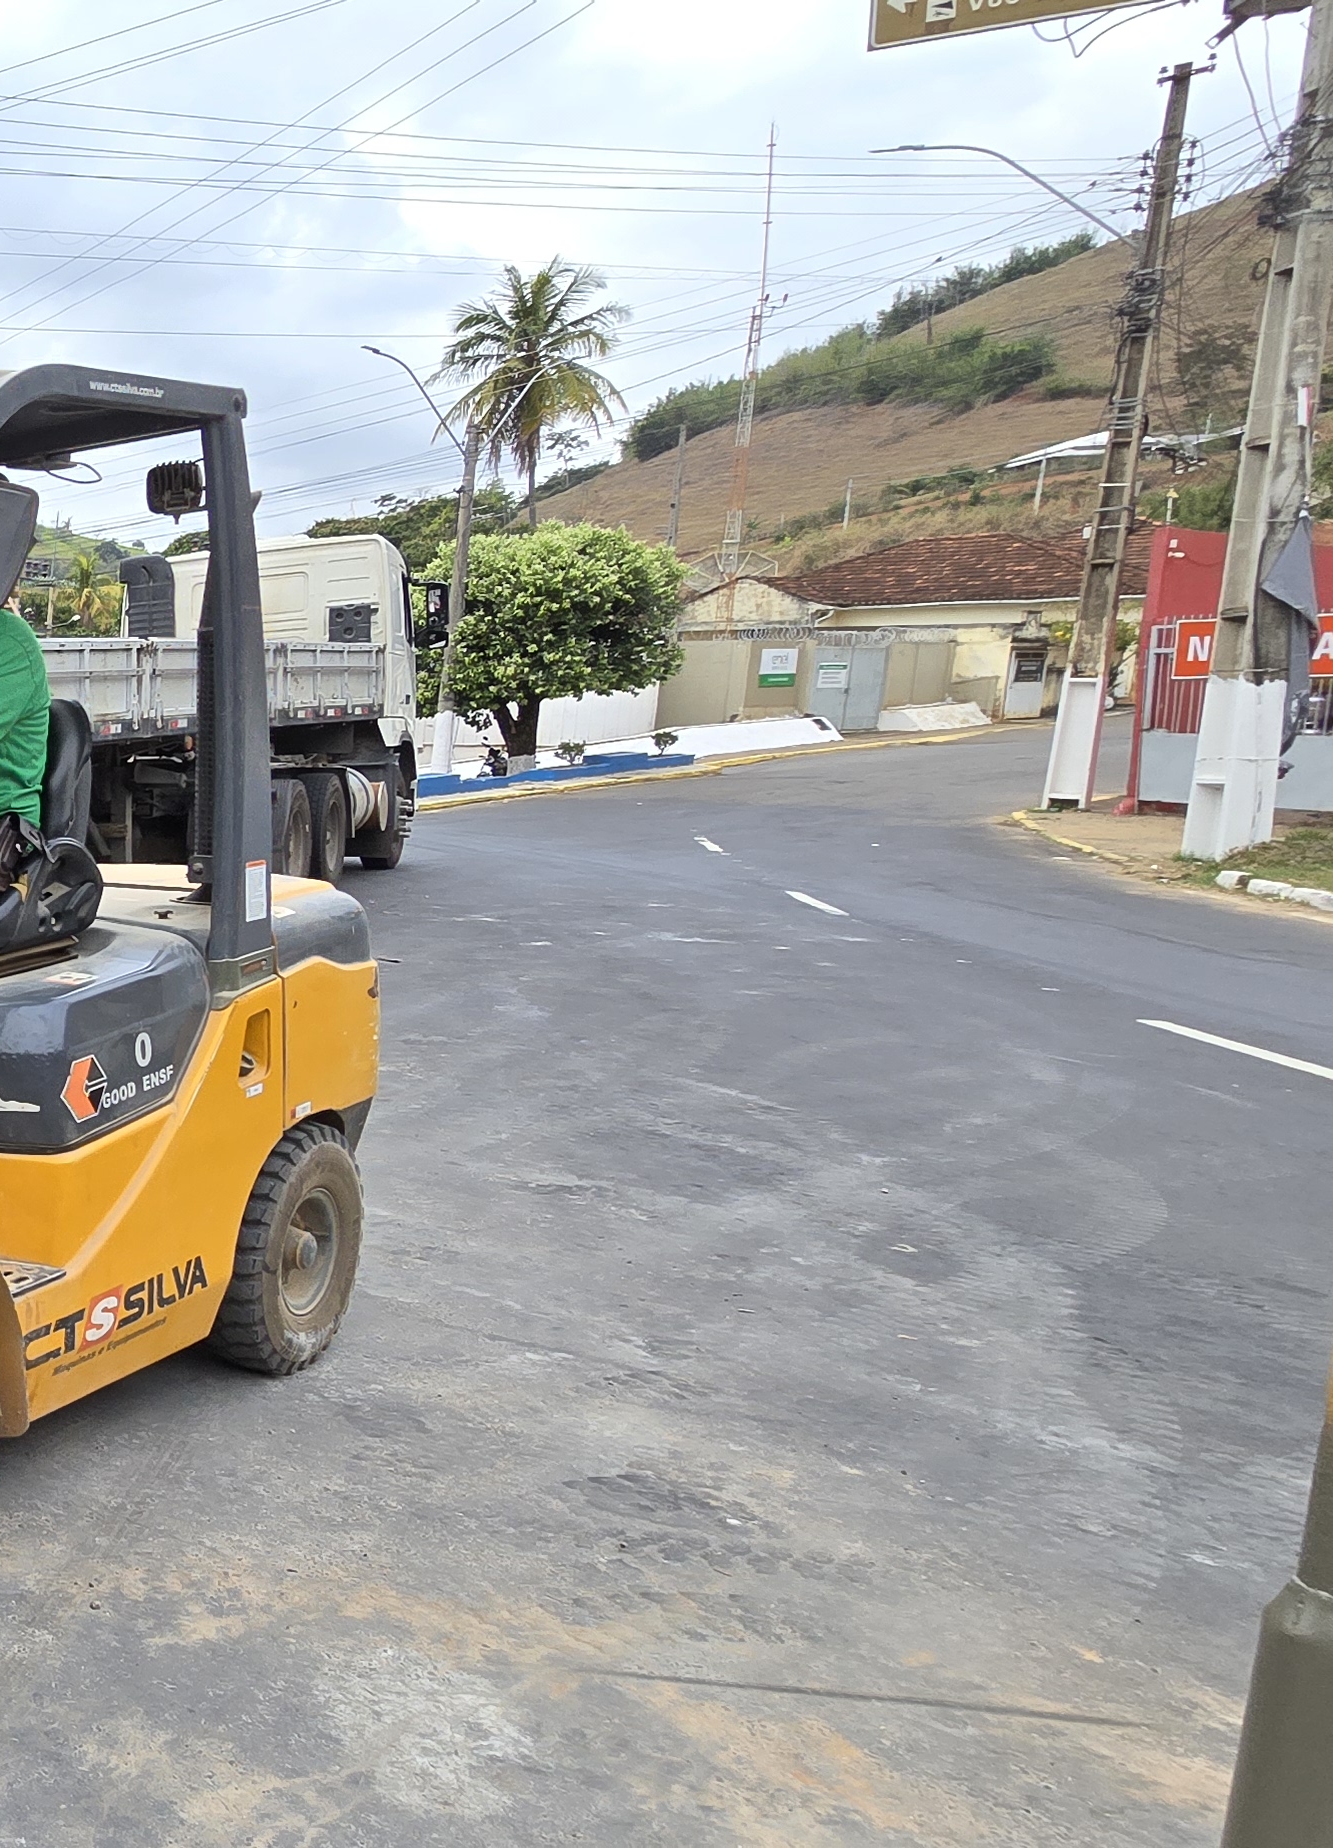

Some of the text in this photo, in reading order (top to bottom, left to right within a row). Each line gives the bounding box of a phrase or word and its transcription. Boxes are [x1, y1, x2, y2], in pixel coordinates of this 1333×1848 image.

[135, 1032, 152, 1067] 0
[102, 1064, 174, 1108] GOOD ENSF
